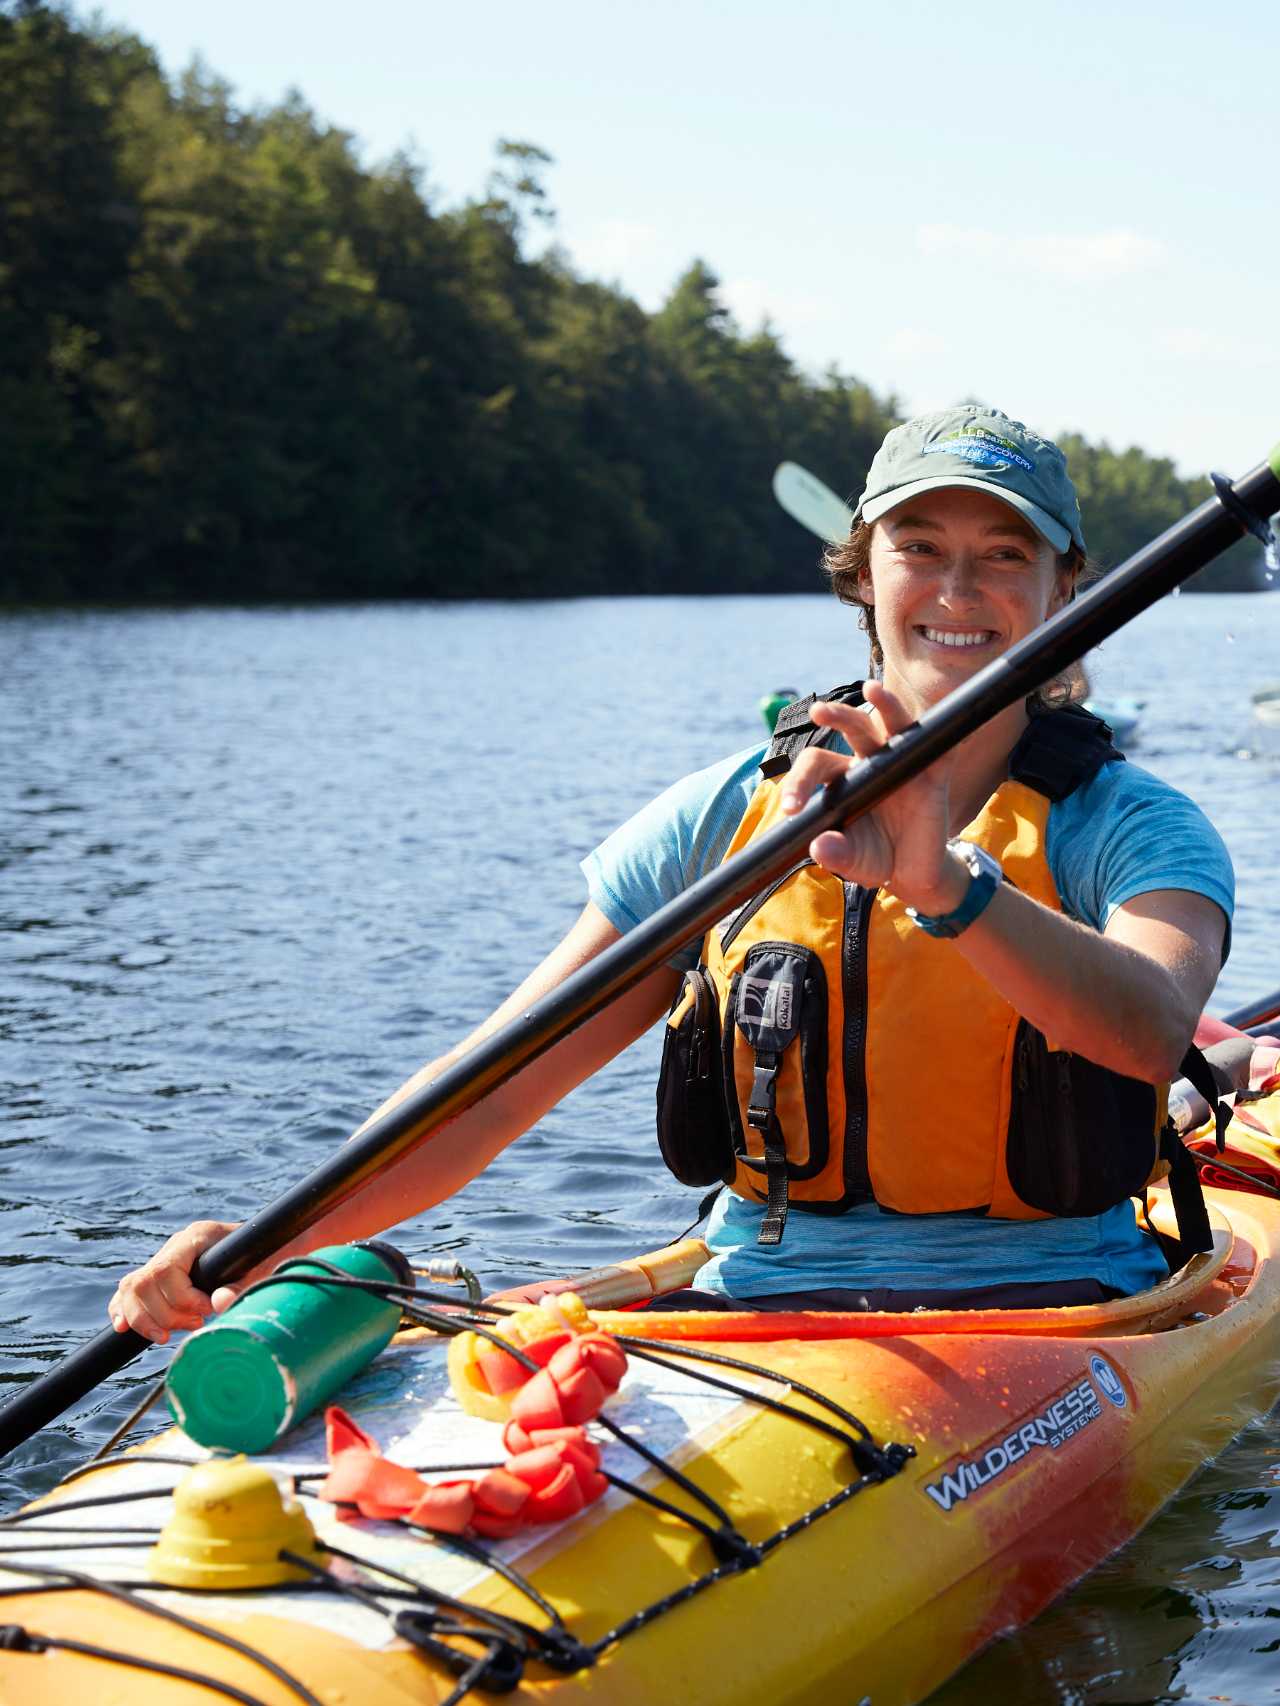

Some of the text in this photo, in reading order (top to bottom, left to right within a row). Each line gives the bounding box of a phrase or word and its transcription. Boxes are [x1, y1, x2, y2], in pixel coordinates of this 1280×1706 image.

[978, 440, 1033, 470] DISCOVERY
[925, 1380, 1097, 1511] WILDERNESS
[1049, 1403, 1102, 1449] SYSTEMS
